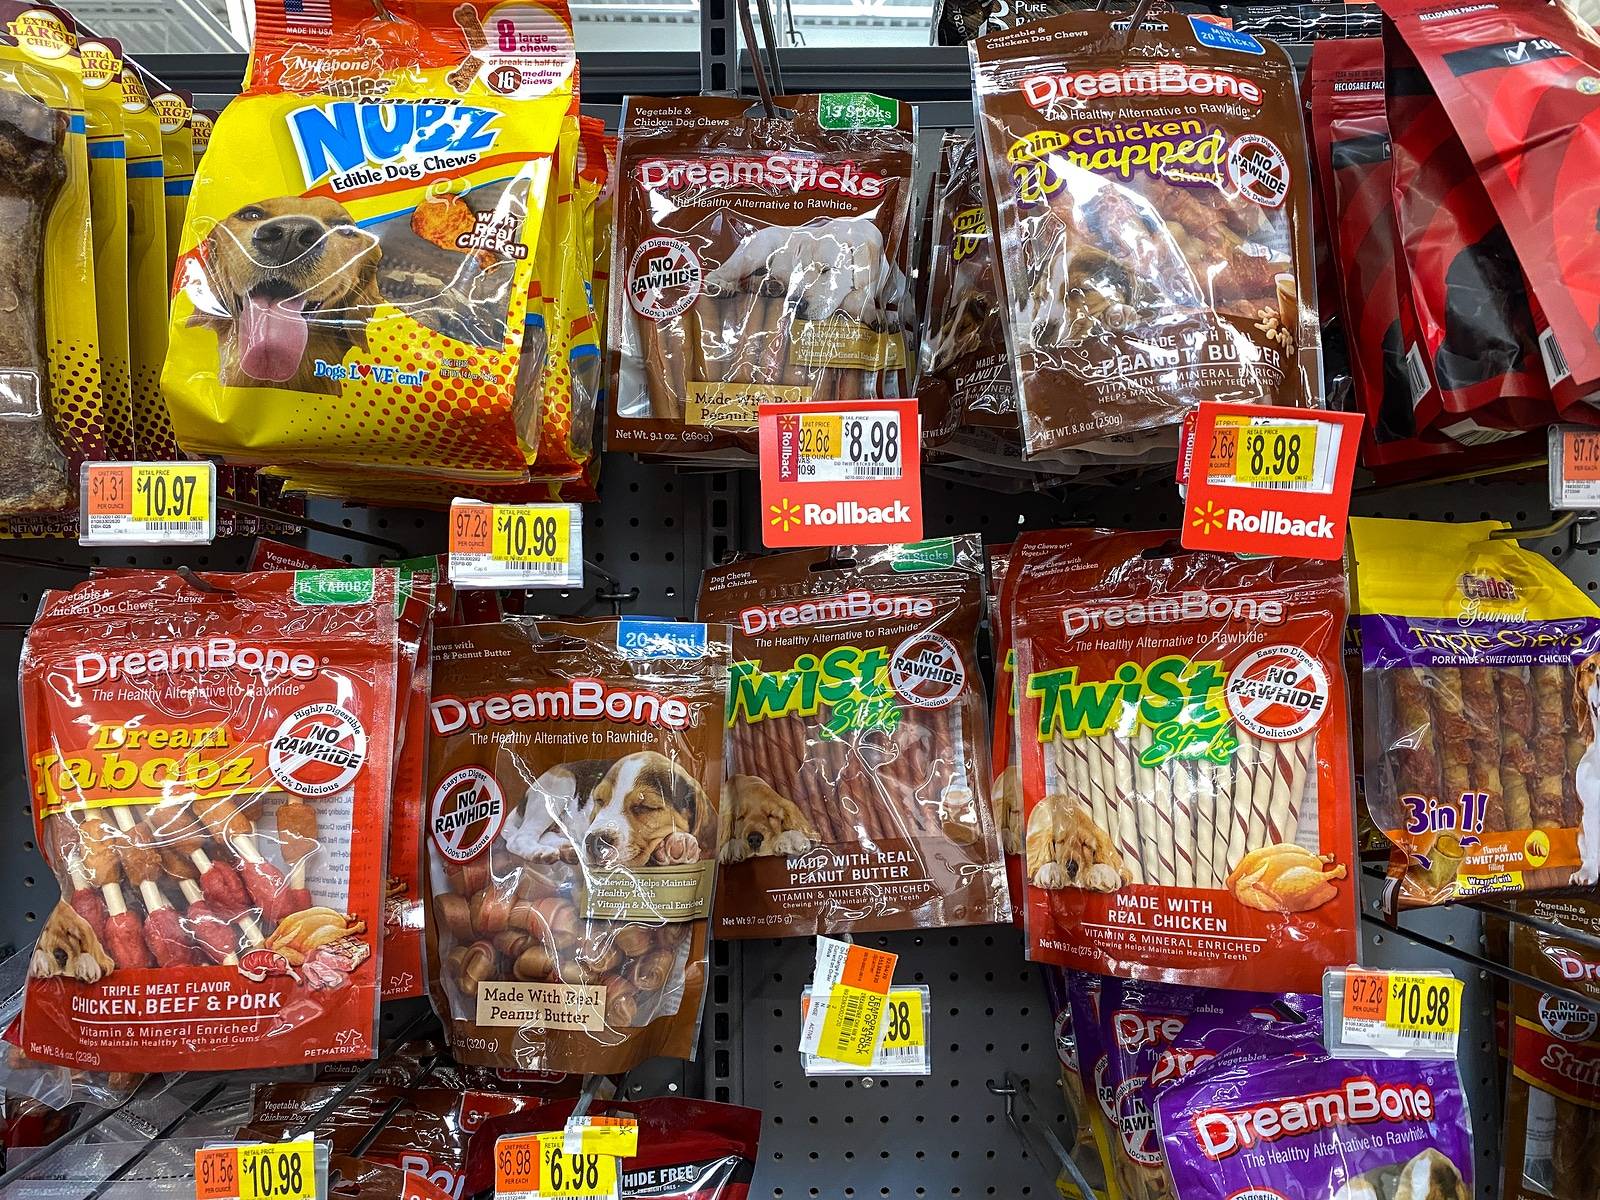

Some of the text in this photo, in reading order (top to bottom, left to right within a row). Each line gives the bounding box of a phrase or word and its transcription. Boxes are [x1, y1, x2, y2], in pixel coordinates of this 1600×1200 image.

[11, 24, 77, 46] LARGE
[22, 16, 63, 32] EXTRA
[286, 26, 308, 35] MADE
[318, 28, 334, 36] USA
[497, 19, 548, 52] 8 large
[1210, 27, 1237, 39] MINI
[26, 37, 64, 51] CHEW
[519, 43, 558, 53] chews
[986, 30, 1089, 50] Chicken Dog Chews
[1201, 30, 1257, 49] 20 STICKS
[496, 69, 562, 89] 16 medium
[1024, 64, 1261, 106] DreamBone
[1334, 82, 1371, 91] RECLOSABLE
[633, 117, 730, 128] Chicken Dog Chews
[635, 106, 693, 117] Vegetable &
[292, 101, 502, 184] NUBZ
[1011, 131, 1063, 160] mini
[1072, 121, 1202, 147] Chicken
[332, 152, 478, 192] Edible Dog Chews
[1253, 151, 1273, 171] NO
[640, 155, 882, 198] DreamSticks
[1231, 153, 1287, 196] RAWHIDE
[456, 234, 528, 259] Chicken
[649, 256, 674, 274] NO
[631, 267, 700, 297] RAWHIDE
[694, 392, 732, 407] Made
[615, 429, 632, 440] Net
[633, 429, 649, 440] Wt.
[681, 431, 714, 443] (260g)
[844, 420, 898, 463] $8.98
[781, 431, 793, 479] Rollback
[1246, 434, 1301, 476] $8.98
[93, 476, 125, 502] $1.31
[137, 475, 197, 517] $10.97
[803, 500, 912, 527] Rollback
[1226, 508, 1336, 540] Rollback
[456, 514, 489, 539] 97.2¢
[497, 514, 558, 558] $10.98
[318, 581, 370, 593] KABOBZ
[741, 591, 934, 636] DreamBone
[1063, 590, 1284, 638] DreamBone
[1457, 596, 1529, 628] Gourmet
[455, 640, 475, 650] with
[625, 632, 648, 648] 20
[755, 638, 773, 648] The
[774, 634, 810, 648] Healthy
[812, 629, 864, 644] Alternative
[865, 628, 876, 639] to
[1076, 639, 1095, 652] The
[1095, 638, 1134, 652] Healthy
[1136, 632, 1195, 648] Alternative
[1197, 632, 1208, 645] to
[75, 637, 316, 685] DreamBone
[918, 649, 944, 668] NO
[893, 656, 964, 687] RAWHIDE
[1267, 666, 1298, 687] NO
[1230, 678, 1326, 712] RAWHIDE
[431, 681, 687, 735] DreamBone
[93, 721, 229, 750] Dream
[311, 723, 341, 745] NO
[272, 736, 363, 770] RAWHIDE
[458, 789, 477, 809] NO
[434, 799, 501, 834] RAWHIDE
[786, 850, 915, 871] MADE WITH REAL
[789, 865, 910, 886] PEANUT BUTTER
[772, 884, 931, 903] VITAMIN & MINERAL ENRICHED
[1116, 894, 1213, 915] MADE WITH
[1108, 909, 1229, 933] REAL CHICKEN
[1084, 927, 1262, 954] VITAMIN & MINERAL ENRICHED
[1093, 939, 1248, 961] Chewing Helps Maintain Healthy Teeth
[101, 980, 231, 997] TRIPLE MEAT FLAVOR
[484, 987, 600, 1007] Made With Real
[1352, 978, 1383, 1005] 97.2¢
[71, 991, 282, 1017] CHICKEN, BEEF & PORK
[490, 1005, 590, 1025] Peanut Butter
[1392, 982, 1450, 1026] $10.98
[856, 995, 875, 1055] OUT OF STOCK
[1541, 1010, 1596, 1023] RAWHIDE
[79, 1034, 260, 1048] Helps Maintain Healthy Teeth and Gums
[80, 1022, 259, 1039] Vitamin & Mineral Enriched
[304, 1046, 358, 1057] PETMATRIX
[264, 1101, 299, 1111] Vegetable
[1196, 1081, 1432, 1155] DreamBone
[499, 1150, 531, 1176] $6.98
[1244, 1152, 1266, 1169] The
[1269, 1148, 1310, 1166] Healthy
[1313, 1139, 1370, 1157] Alternative
[1372, 1135, 1383, 1148] to
[202, 1155, 235, 1185] 91.5¢
[243, 1152, 303, 1197] $10.98
[515, 1177, 529, 1185] EACH
[545, 1148, 599, 1191] $6.98
[660, 1164, 694, 1182] FREE
